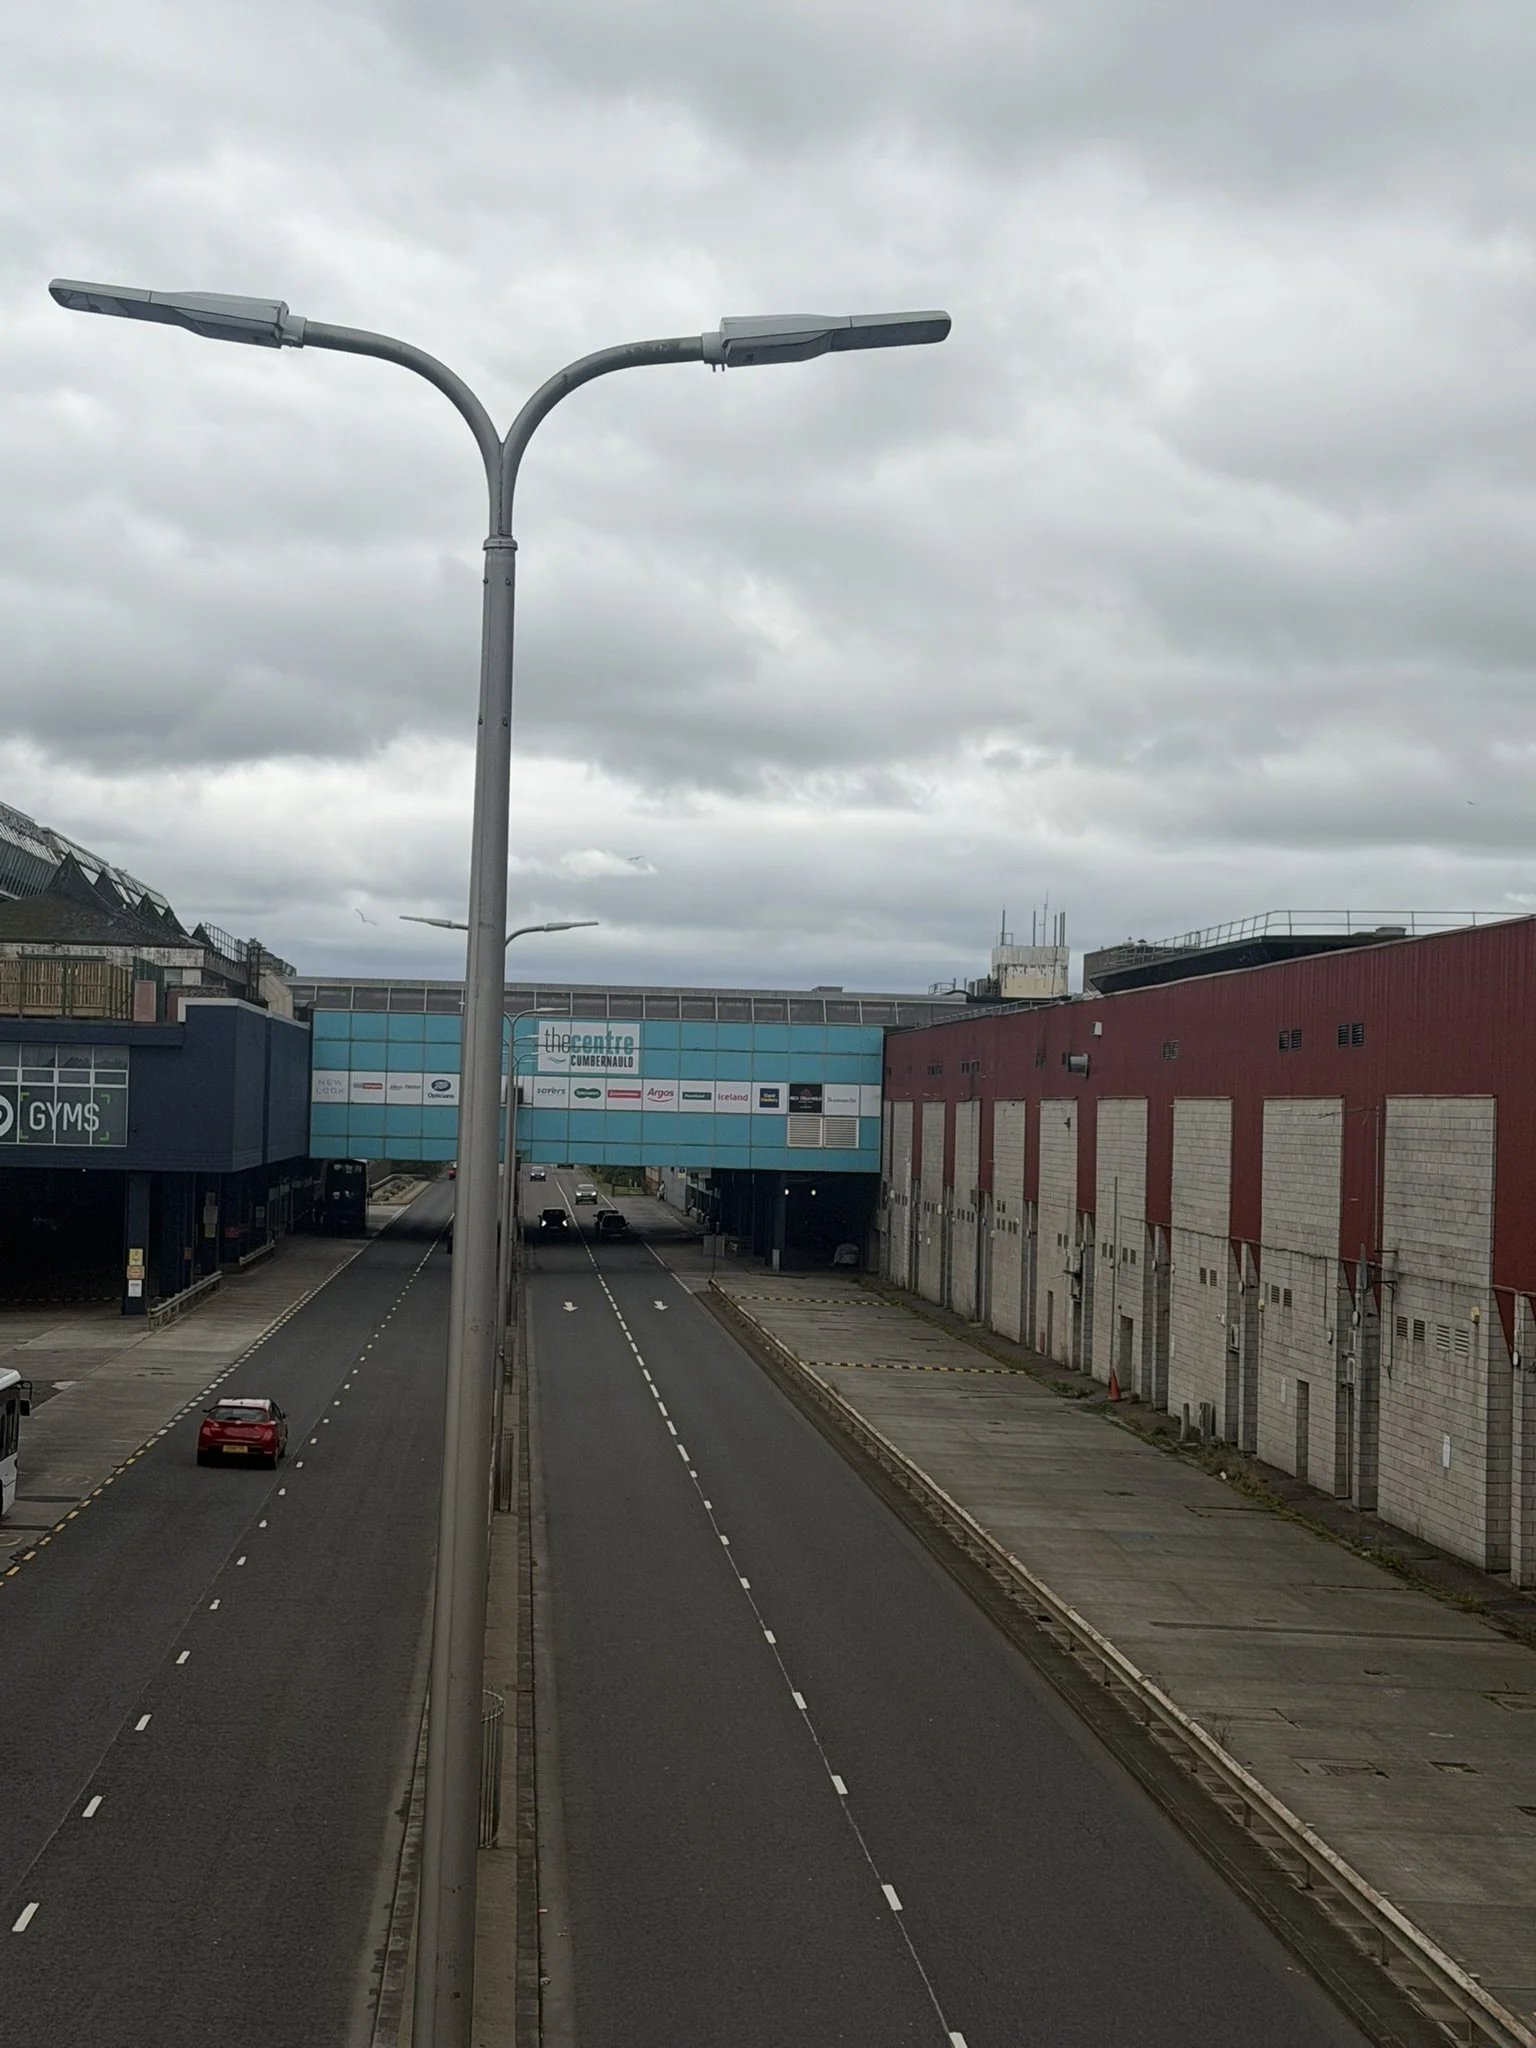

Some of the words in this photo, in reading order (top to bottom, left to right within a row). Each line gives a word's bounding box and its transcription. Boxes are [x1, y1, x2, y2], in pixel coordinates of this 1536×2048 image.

[570, 1055, 634, 1068] CUMBERNAULD
[647, 1088, 675, 1099] Argos
[717, 1093, 749, 1102] Iceland
[29, 1101, 100, 1132] GYMS
